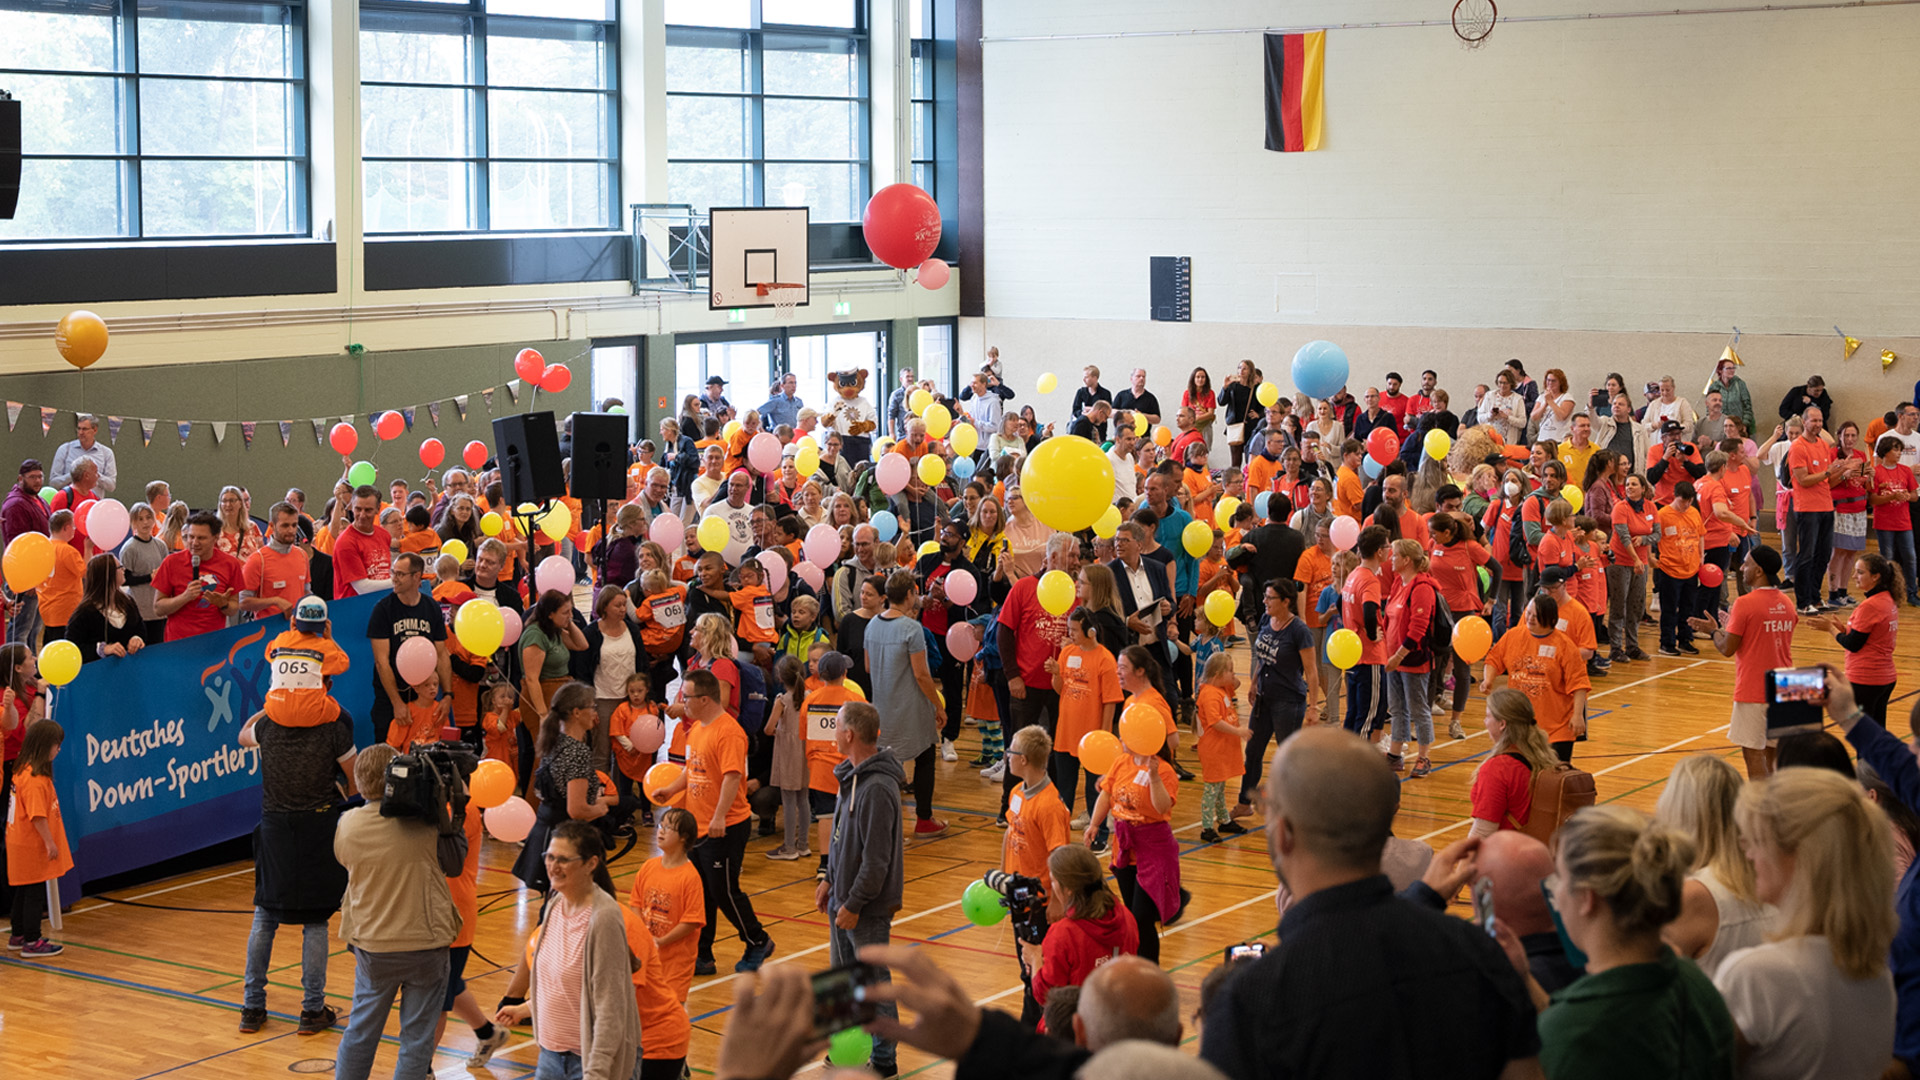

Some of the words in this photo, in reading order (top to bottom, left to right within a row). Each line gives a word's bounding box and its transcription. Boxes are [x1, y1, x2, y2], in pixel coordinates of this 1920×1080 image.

[1763, 620, 1792, 632] TEAM
[279, 661, 309, 674] 065
[86, 718, 184, 767] Deutsches
